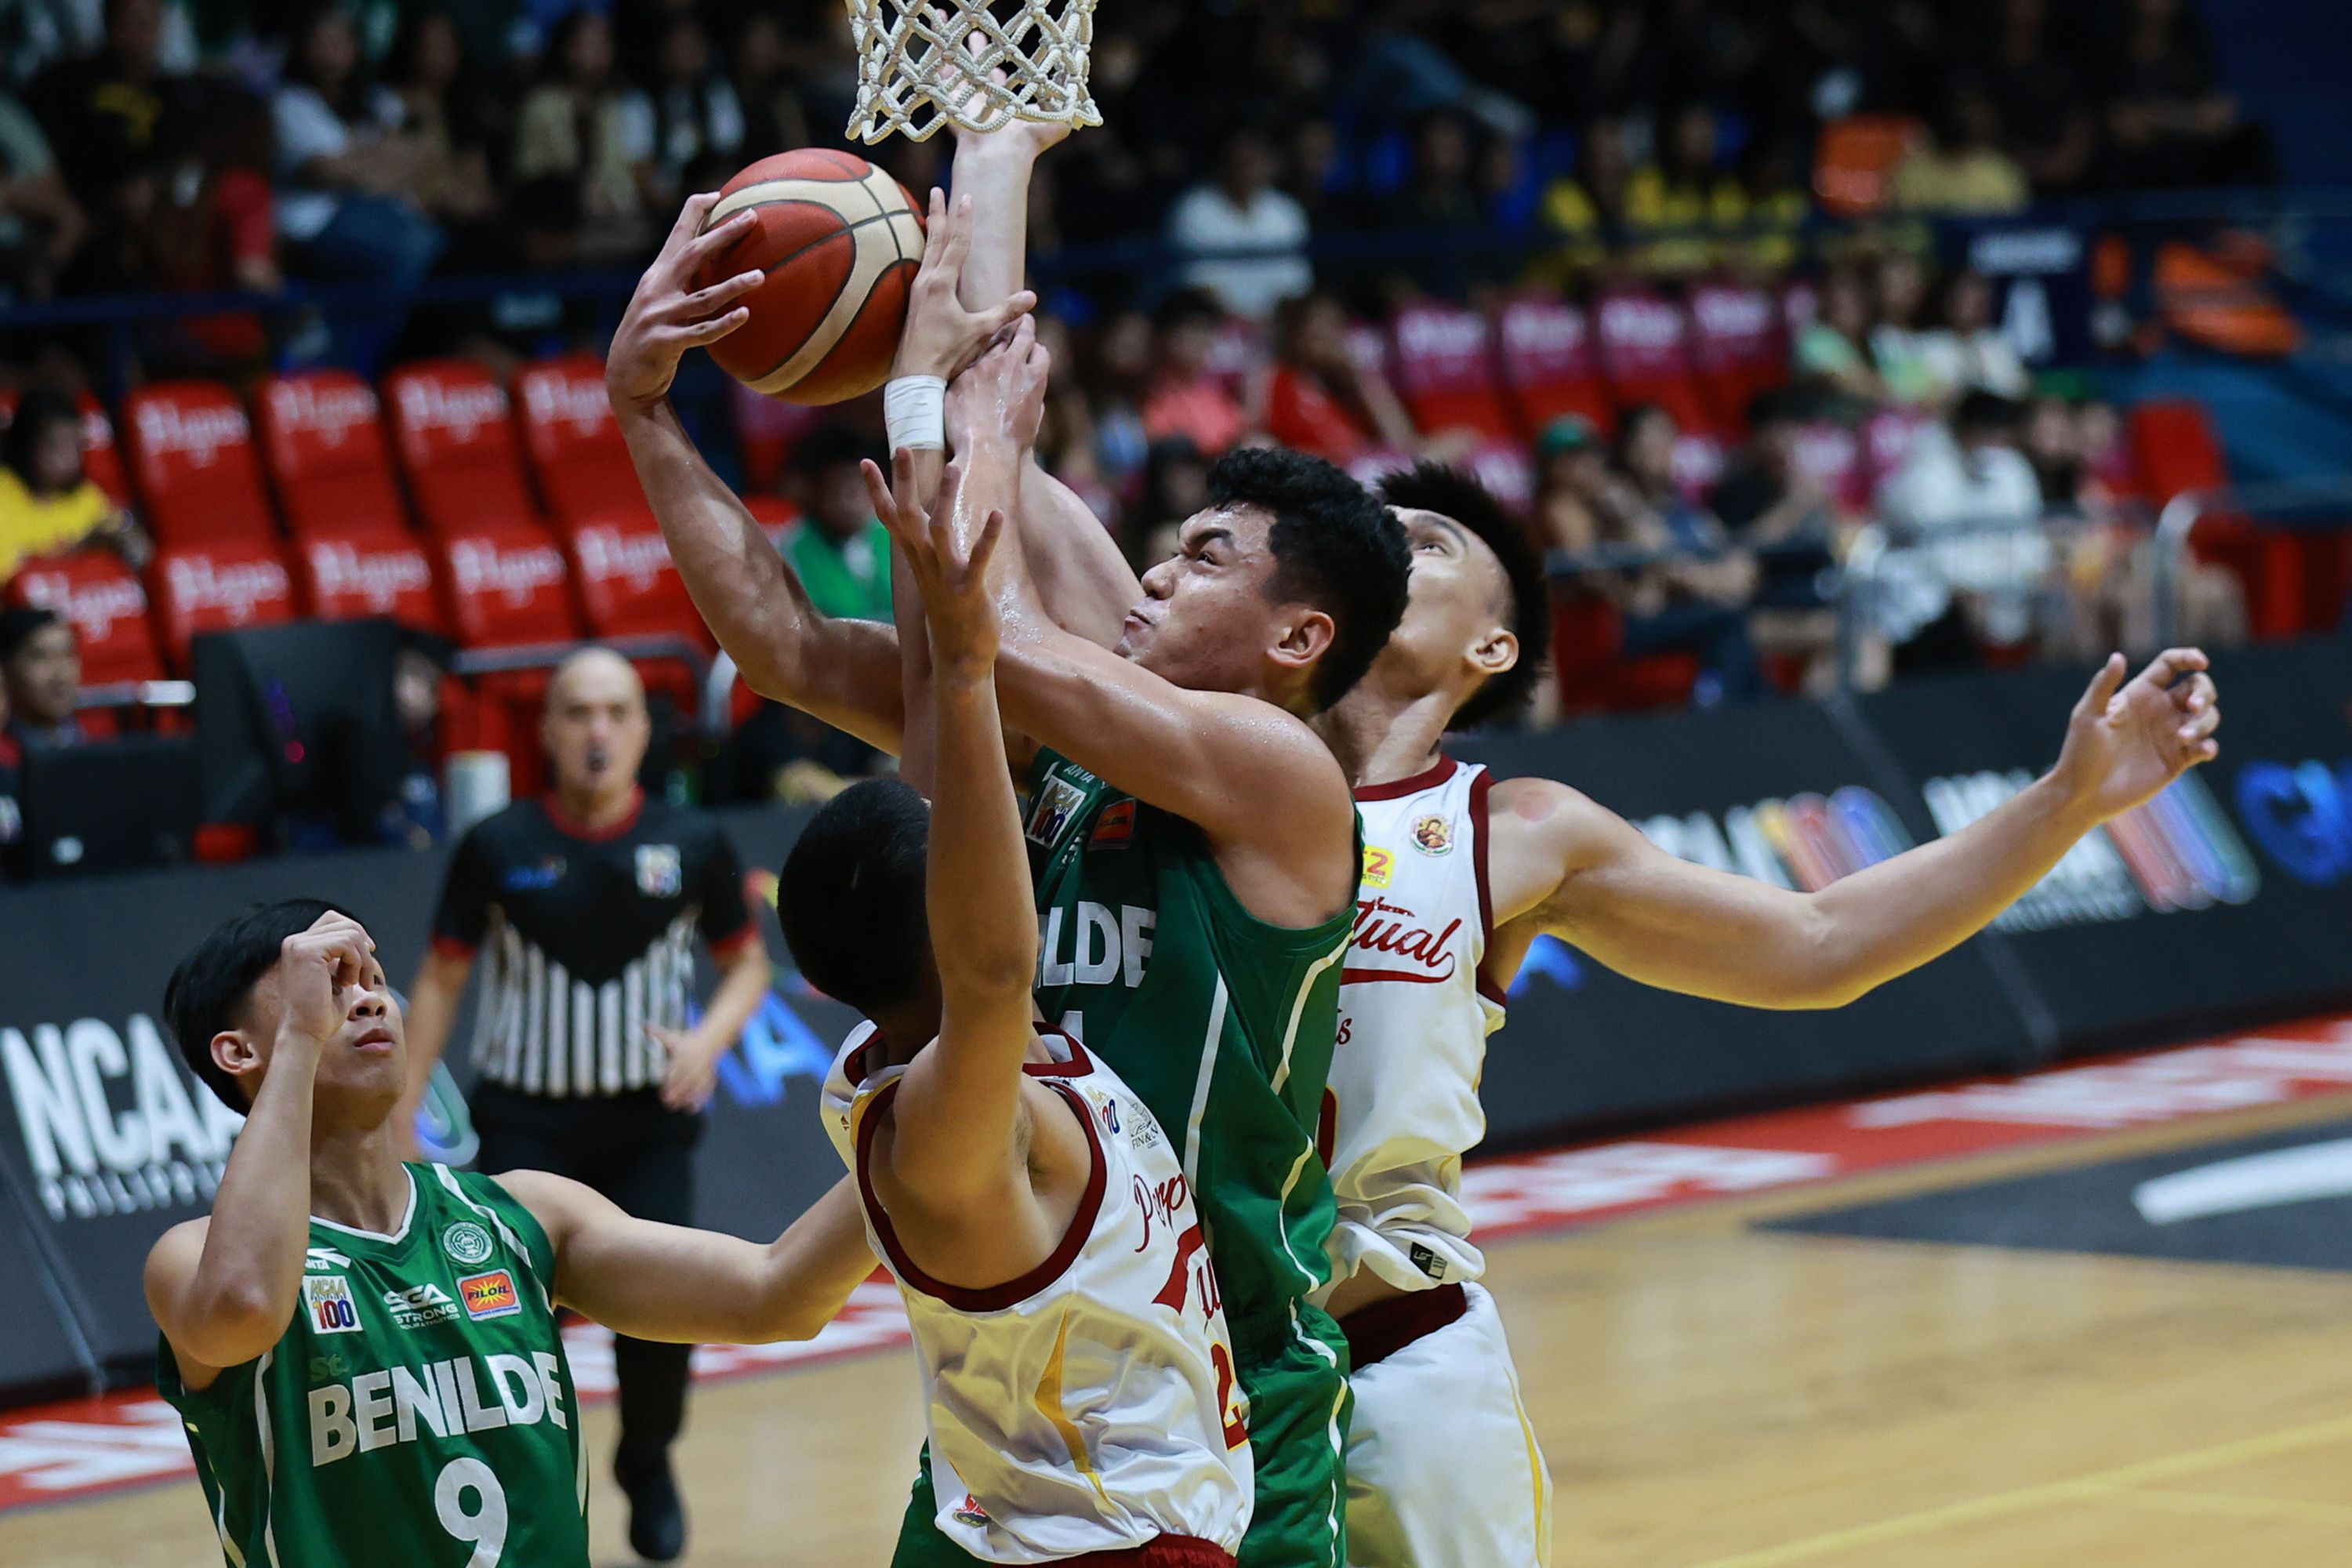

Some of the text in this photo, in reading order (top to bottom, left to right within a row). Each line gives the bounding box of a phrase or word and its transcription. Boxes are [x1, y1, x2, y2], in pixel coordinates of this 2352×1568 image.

[1032, 805, 1065, 843] 100
[1343, 896, 1463, 972] tual
[310, 1279, 346, 1295] NCAA
[467, 1285, 510, 1301] FILOIL
[313, 1300, 355, 1330] 100
[394, 1303, 459, 1324] STRONG
[307, 1351, 568, 1467] BENILDE
[434, 1457, 508, 1568] 9
